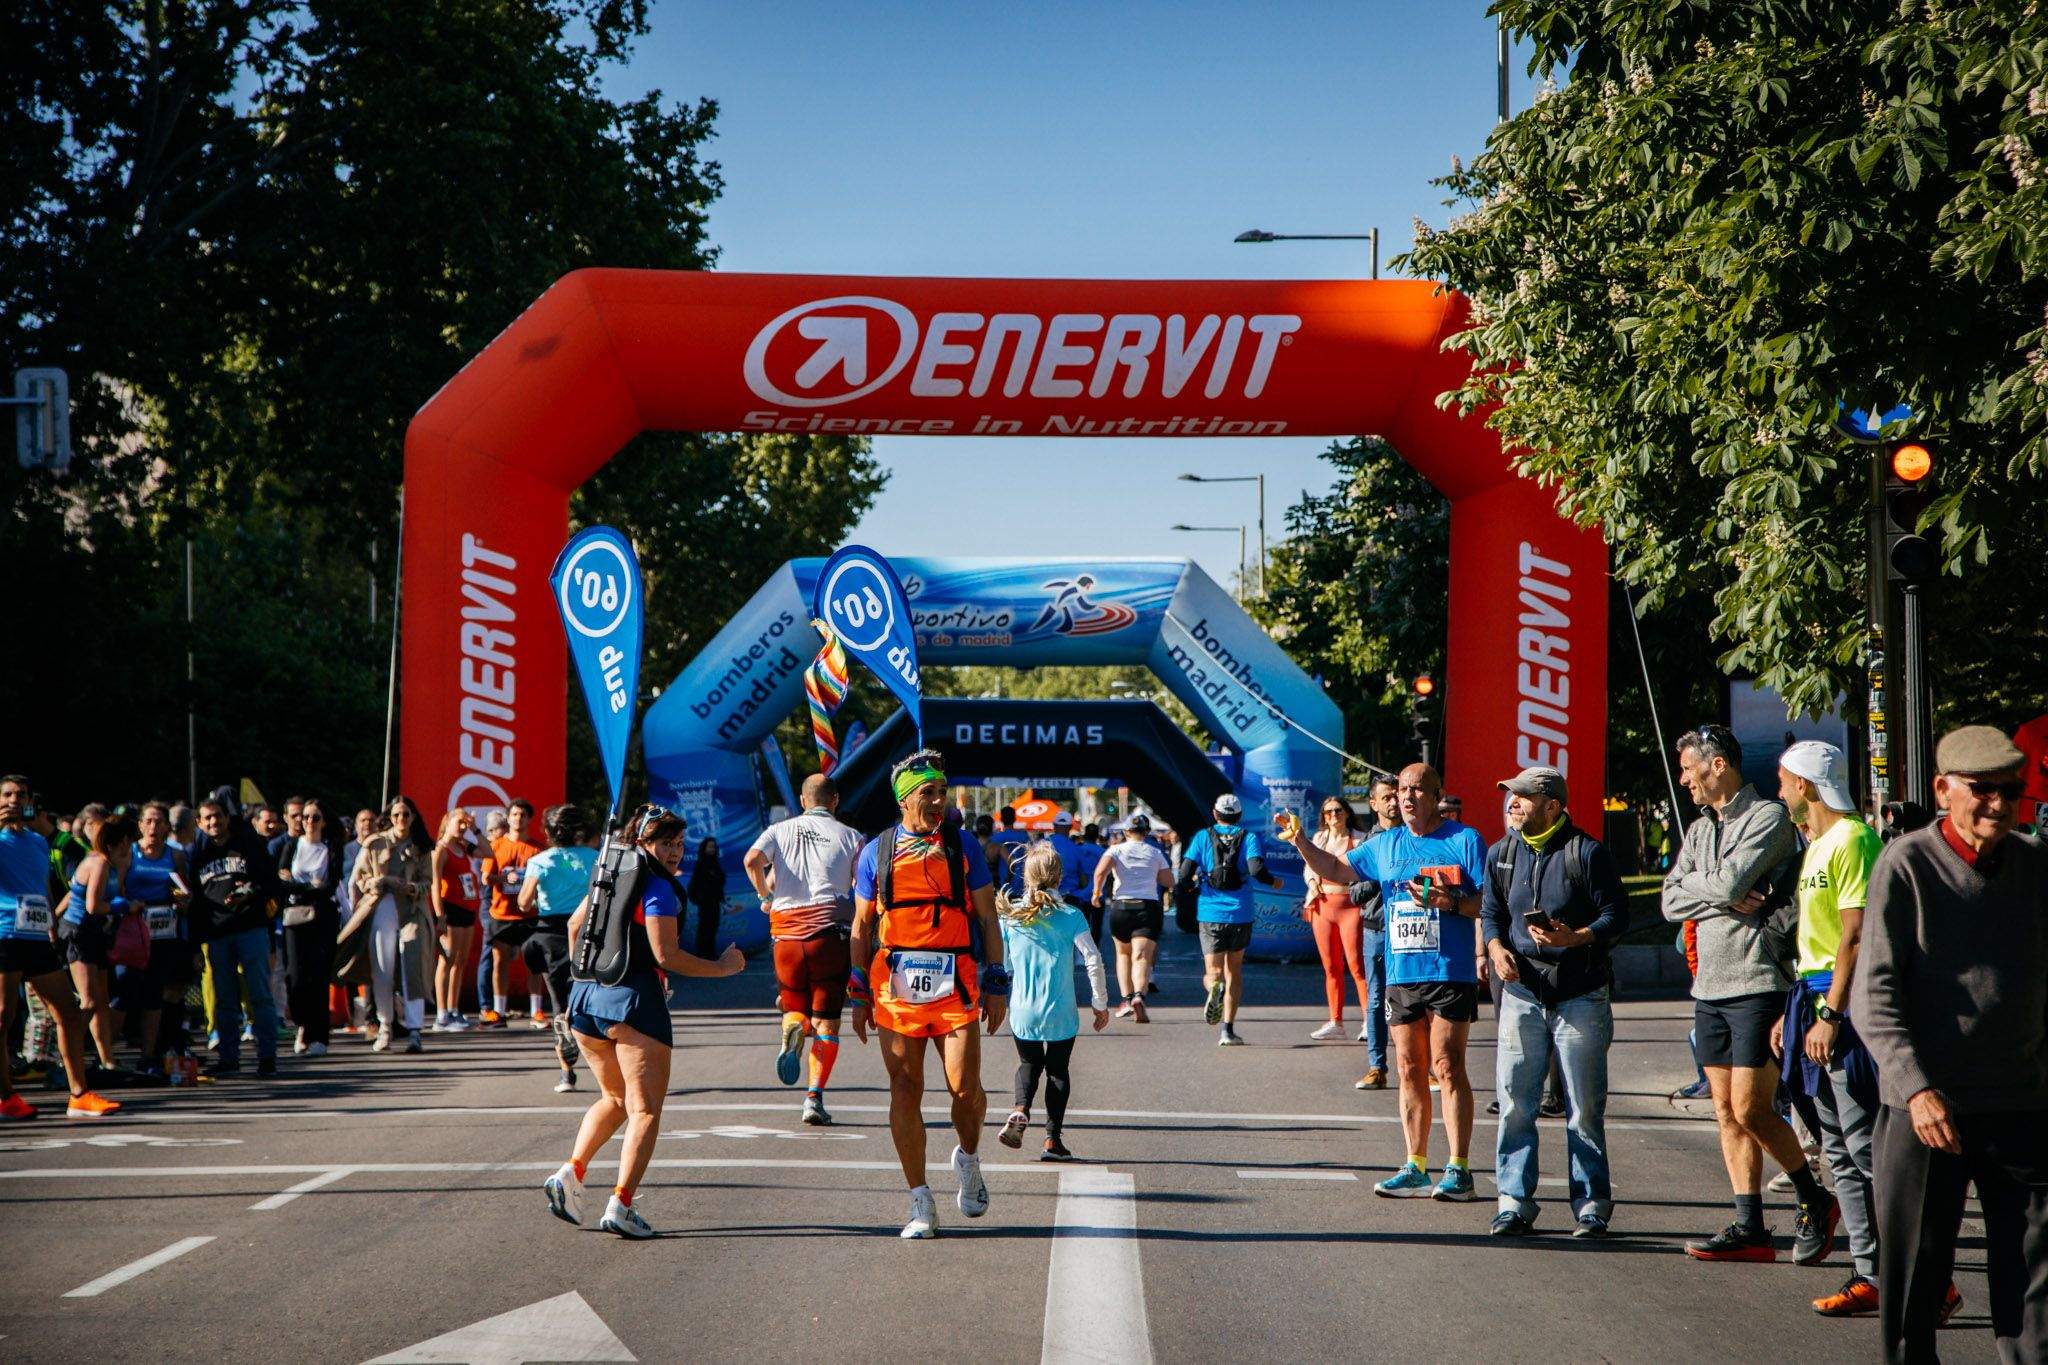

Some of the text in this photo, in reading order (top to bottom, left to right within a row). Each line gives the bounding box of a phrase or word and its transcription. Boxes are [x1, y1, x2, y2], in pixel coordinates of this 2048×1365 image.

[910, 312, 1302, 399] ENERVIT
[740, 411, 1288, 435] Science in Nutrition
[460, 533, 517, 780] ENERVIT
[913, 605, 1010, 627] portivo
[960, 632, 1011, 646] madrid
[690, 610, 794, 720] bomberos
[716, 647, 801, 742] madrid
[1168, 645, 1257, 732] madrid
[1190, 618, 1292, 732] bomberos
[1517, 541, 1571, 781] ENERVIT
[955, 723, 1104, 745] DECIMAS
[1265, 851, 1301, 861] madr
[910, 975, 932, 992] 46
